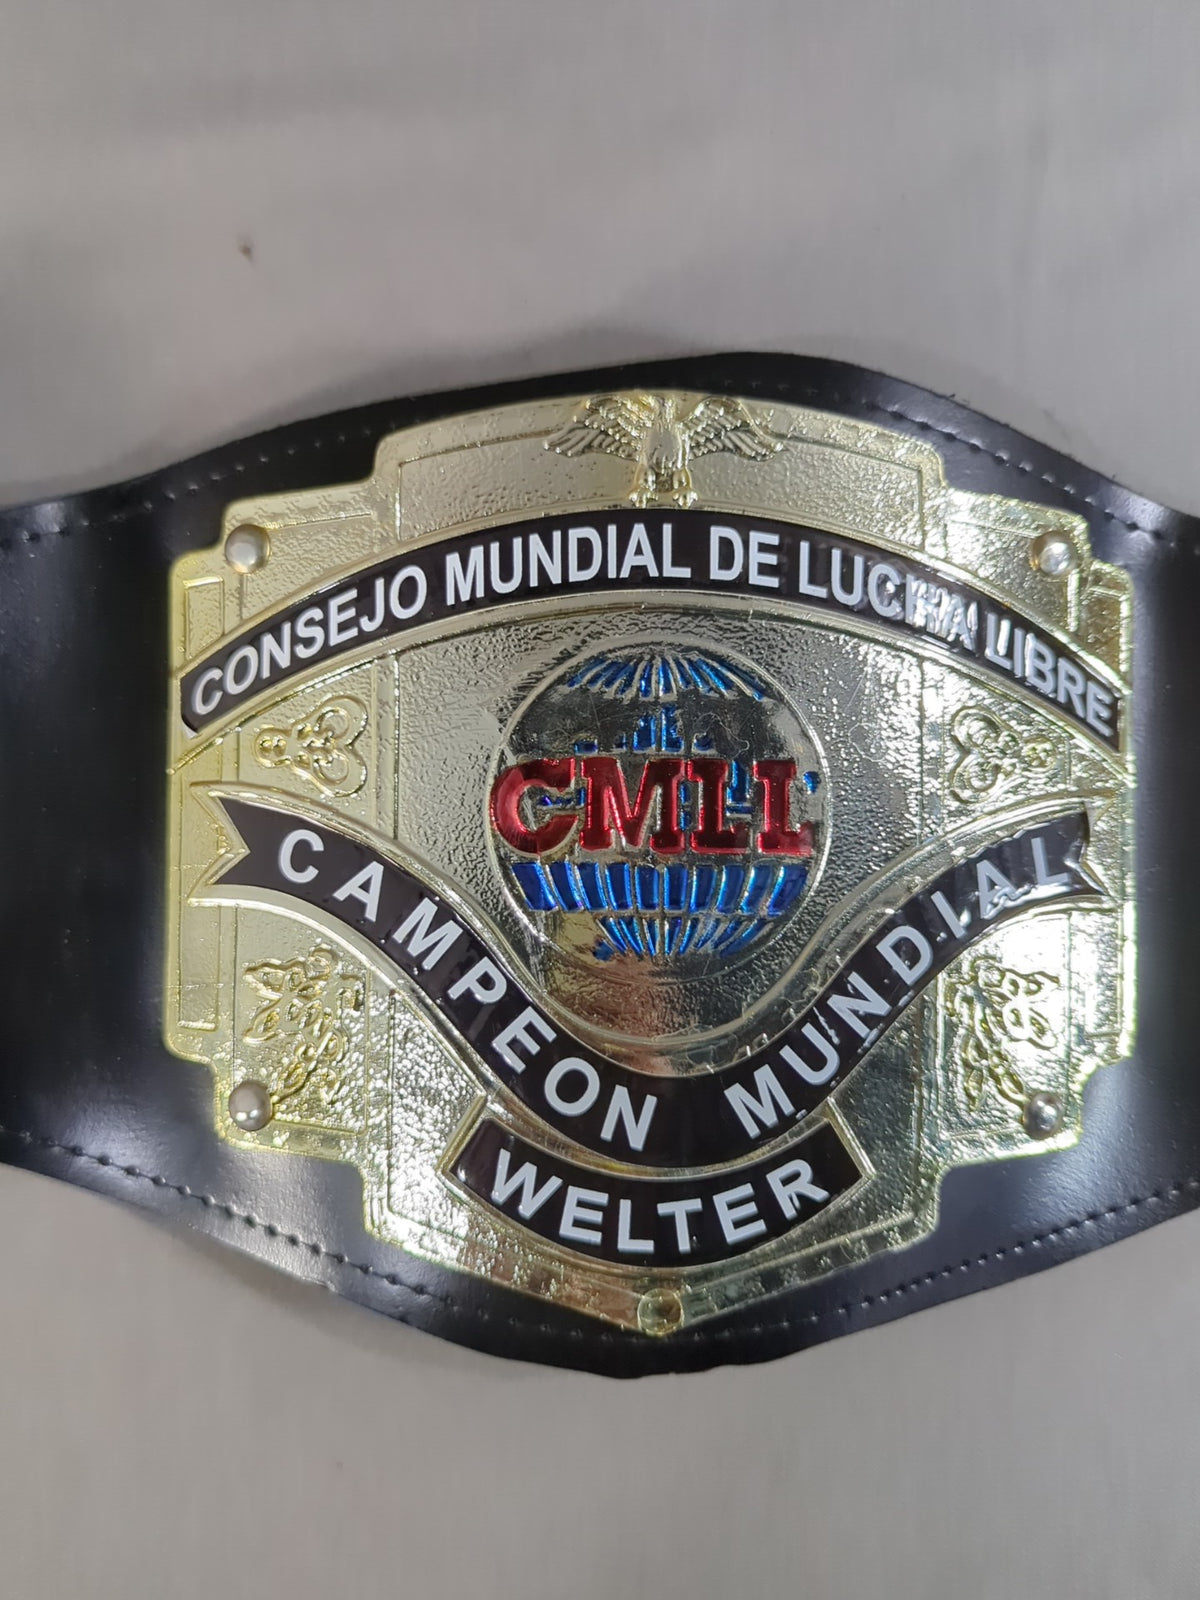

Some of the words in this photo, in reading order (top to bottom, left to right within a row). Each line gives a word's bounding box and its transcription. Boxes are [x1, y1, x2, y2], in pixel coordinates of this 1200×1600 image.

[191, 564, 428, 716] CONSEJO
[445, 522, 691, 606] MUNDIAL
[708, 525, 780, 588] DE
[799, 540, 977, 652] LUCHA
[985, 613, 1112, 737] LIBRE
[489, 756, 813, 855] CMLL
[277, 829, 658, 1151] CAMPEON
[723, 837, 1073, 1140] MUNDIAL
[492, 1148, 830, 1253] WELTER
